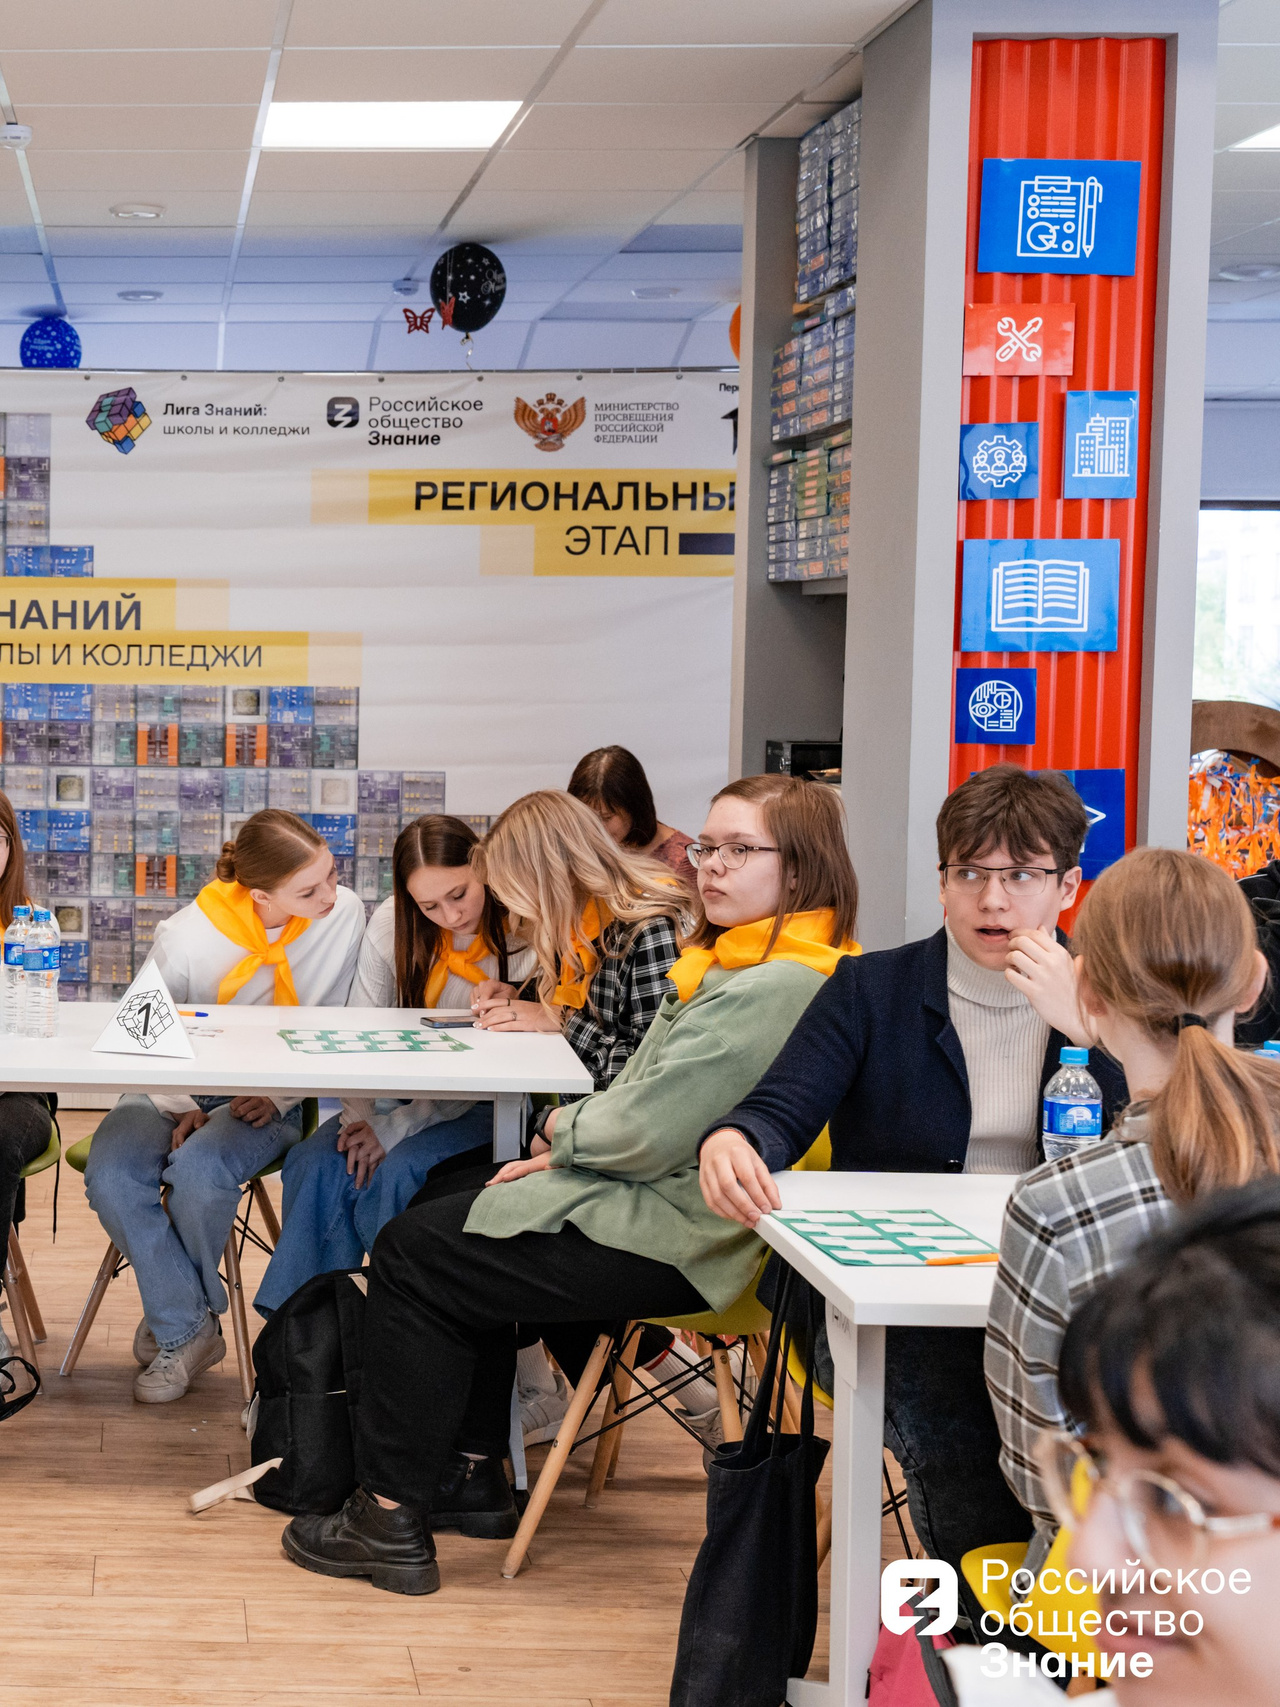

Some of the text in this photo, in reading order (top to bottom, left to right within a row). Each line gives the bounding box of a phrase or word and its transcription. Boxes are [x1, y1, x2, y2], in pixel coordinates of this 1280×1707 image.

[719, 383, 739, 394] Пер
[163, 403, 267, 416] Лига Знаний:
[369, 396, 483, 412] Российское
[594, 402, 680, 412] МИНИСТЕРСТВО
[368, 415, 463, 431] общество
[594, 413, 674, 422] ПРОСВЕЩЕНИЯ
[163, 425, 310, 437] школы и колледжи
[594, 423, 664, 433] РОССИЙСКОЙ
[368, 431, 441, 446] Знание
[594, 434, 658, 444] ФЕДЕРАЦИИ
[565, 525, 669, 556] ЭТАП
[52, 642, 72, 666] И
[82, 643, 263, 671] КОЛЛЕДЖИ
[137, 1002, 152, 1037] 1
